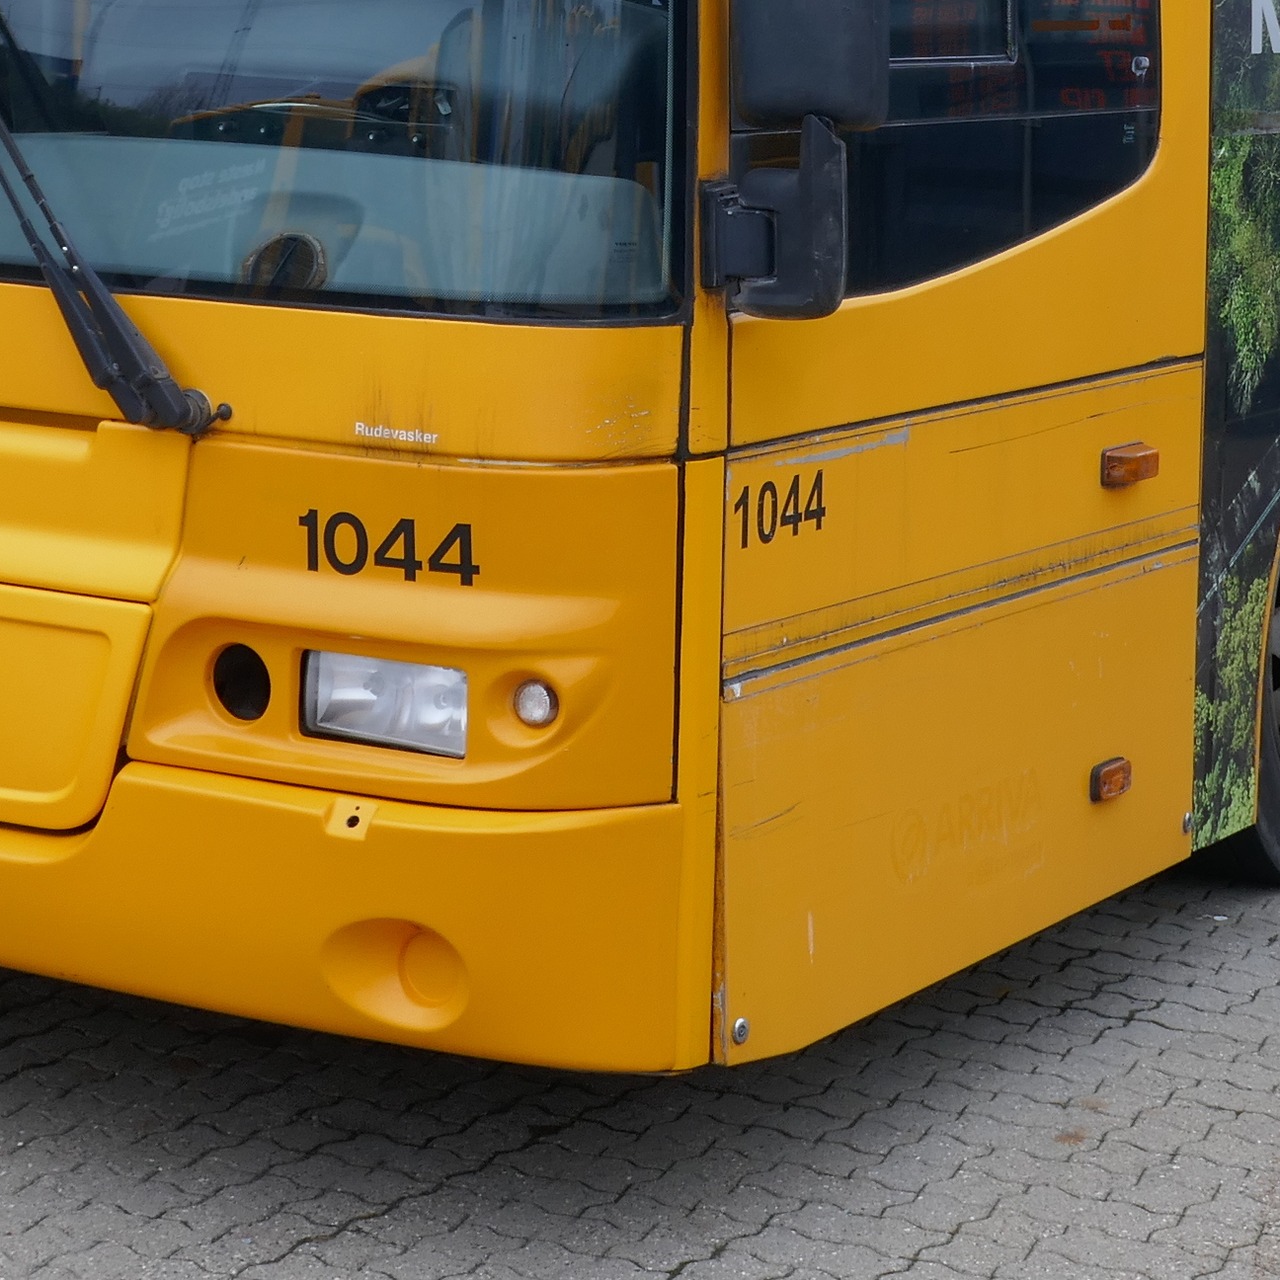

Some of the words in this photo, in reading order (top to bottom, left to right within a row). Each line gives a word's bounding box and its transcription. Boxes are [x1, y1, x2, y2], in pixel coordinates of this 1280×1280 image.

[354, 422, 439, 444] Rudevasker
[298, 508, 481, 587] 1044
[734, 468, 827, 550] 1044
